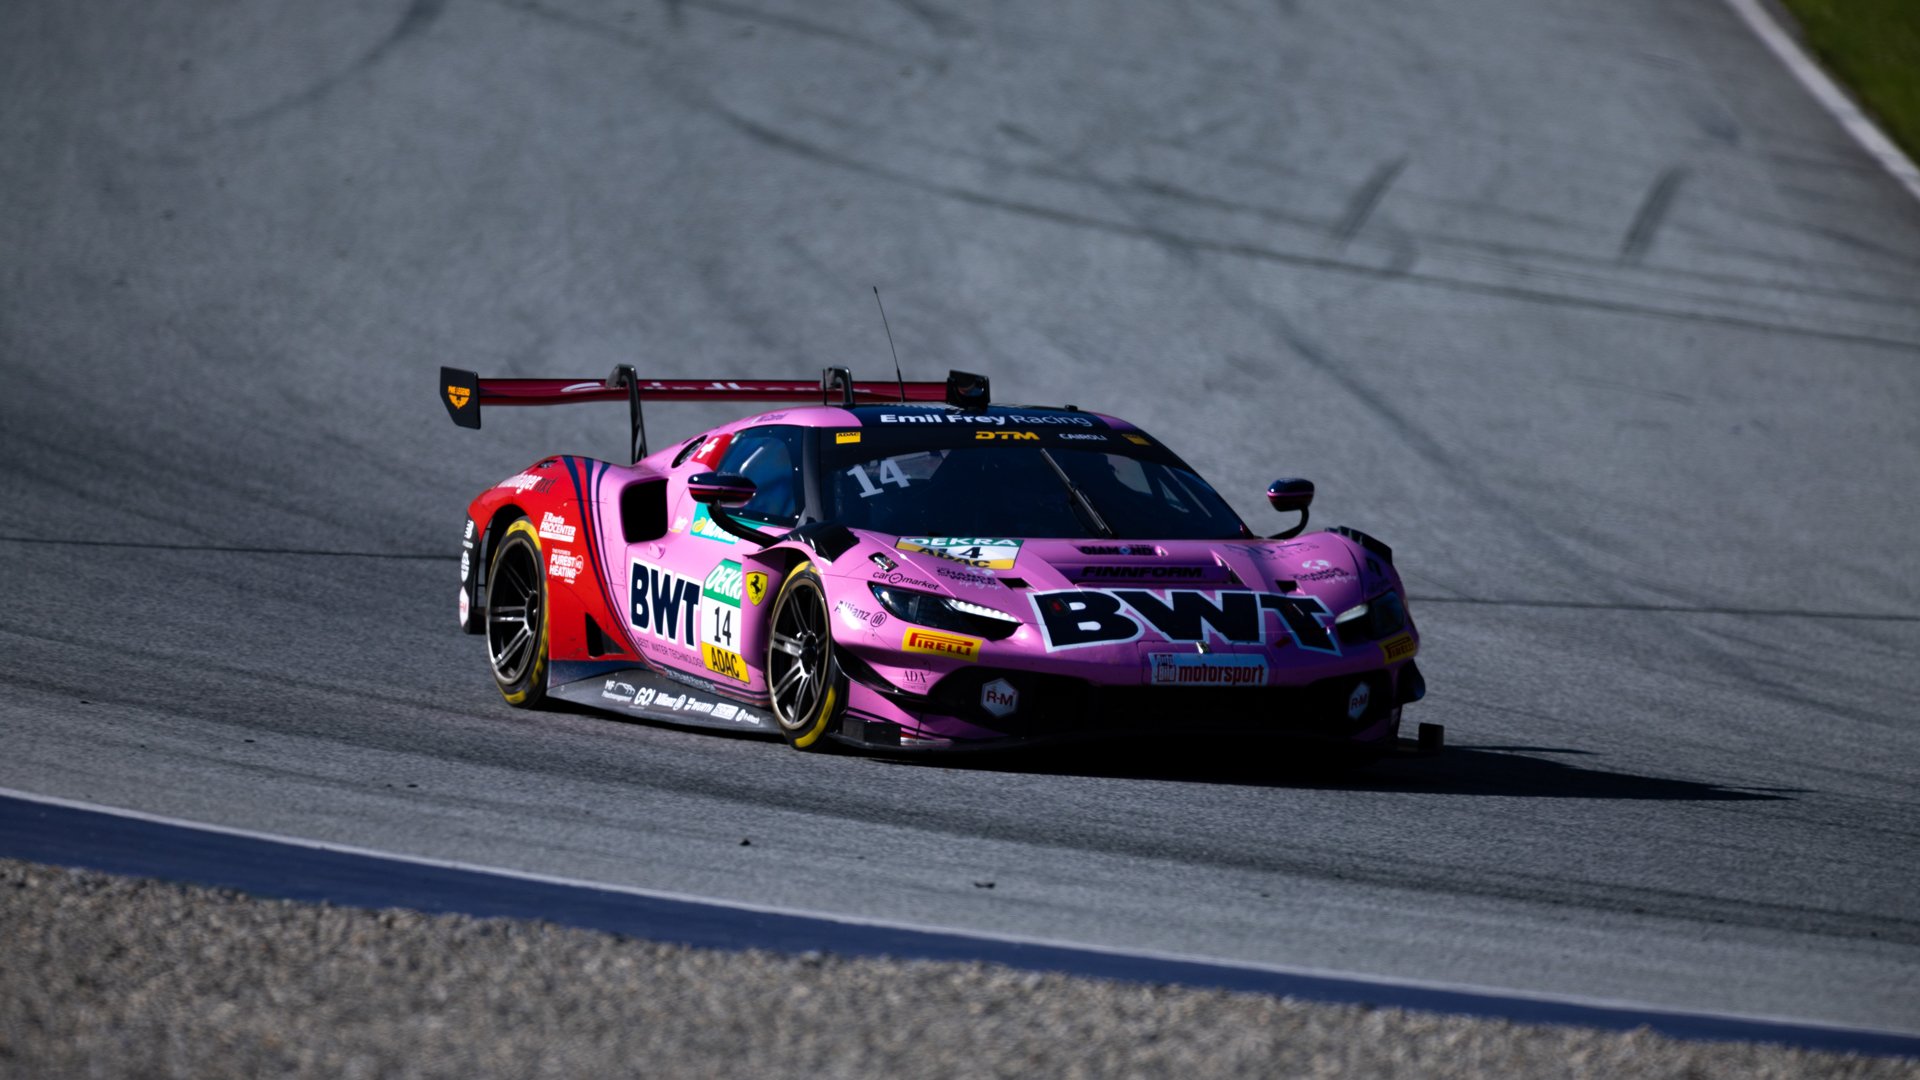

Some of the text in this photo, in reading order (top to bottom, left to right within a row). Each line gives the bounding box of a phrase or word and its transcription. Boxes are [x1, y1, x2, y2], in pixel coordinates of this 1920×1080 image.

[880, 414, 1093, 428] Emil Frey Racing
[975, 431, 1041, 441] DTM
[847, 458, 911, 498] 14
[540, 521, 576, 537] PROCENTER
[908, 537, 1018, 546] DEKRA
[550, 554, 577, 567] PUREST
[549, 565, 577, 580] HEATING
[1081, 566, 1204, 578] FINNFORM
[631, 560, 701, 649] BWT
[714, 606, 732, 647] 14
[1029, 588, 1340, 654] BWT
[909, 632, 974, 657] PIRELLI
[711, 646, 740, 678] ADAC
[1180, 663, 1265, 685] motorsport
